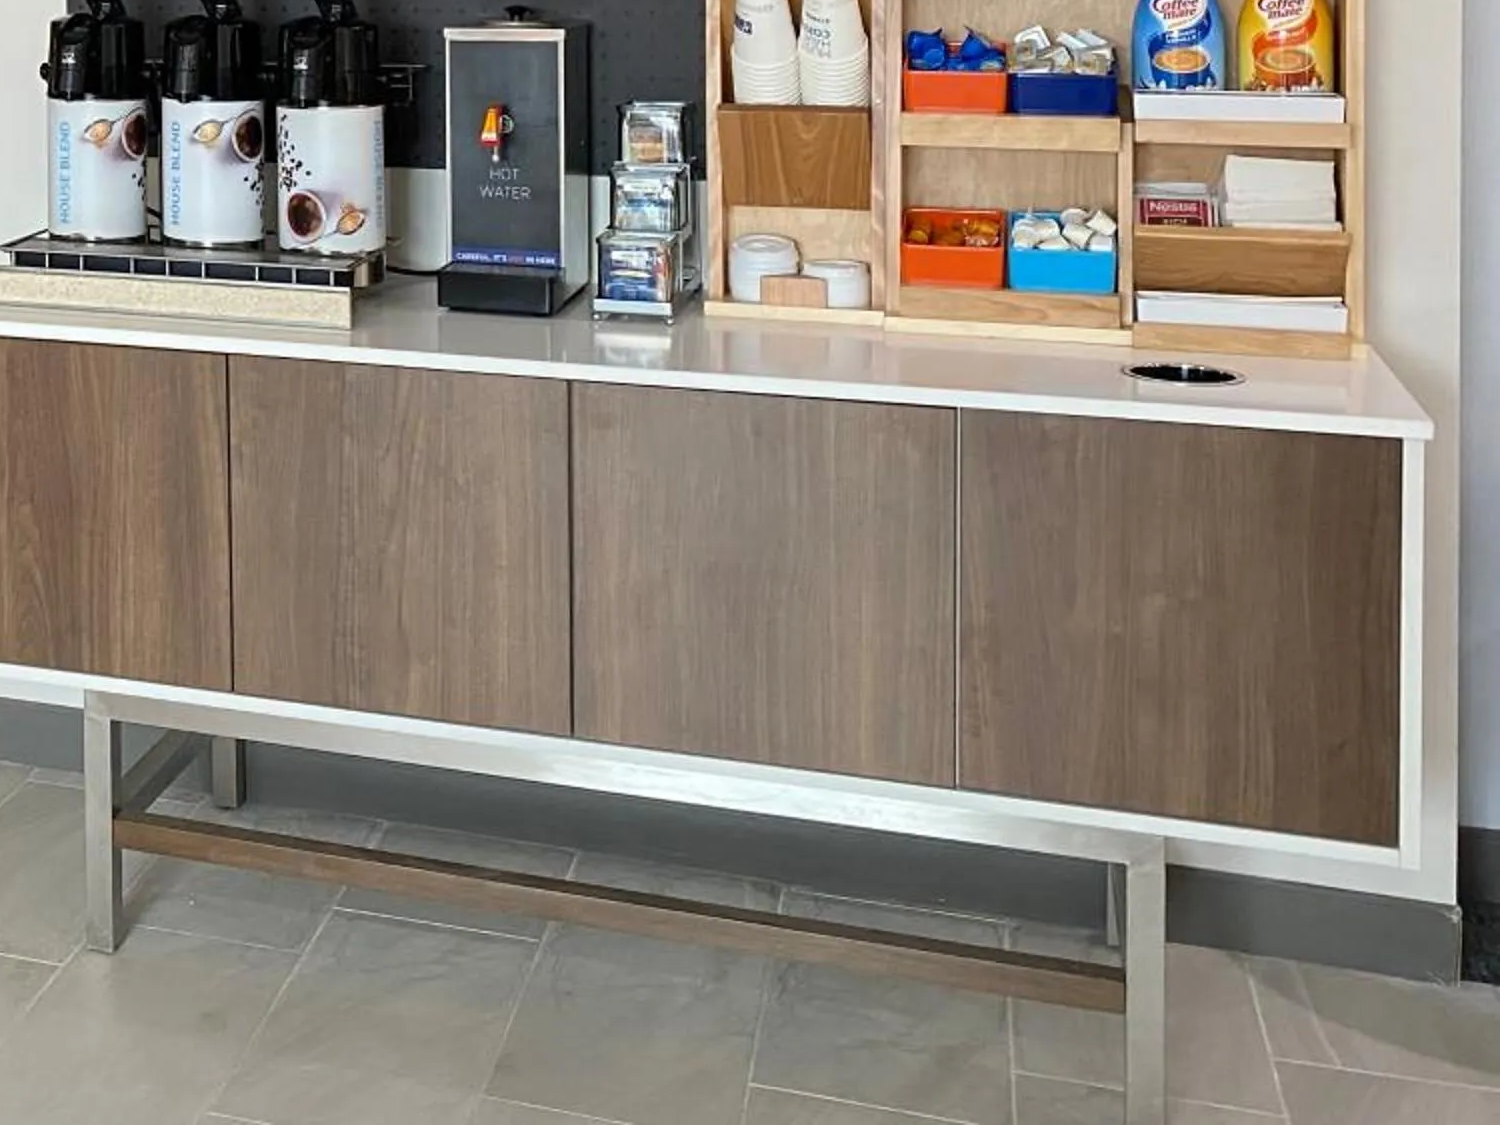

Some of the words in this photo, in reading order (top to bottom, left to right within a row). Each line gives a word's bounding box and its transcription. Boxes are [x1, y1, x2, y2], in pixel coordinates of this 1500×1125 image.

[59, 121, 71, 170] BLEND
[170, 121, 181, 171] BLEND
[479, 185, 532, 200] WATER
[489, 168, 519, 180] HOT
[59, 175, 72, 224] HOUSE
[170, 175, 181, 226] HOUSE
